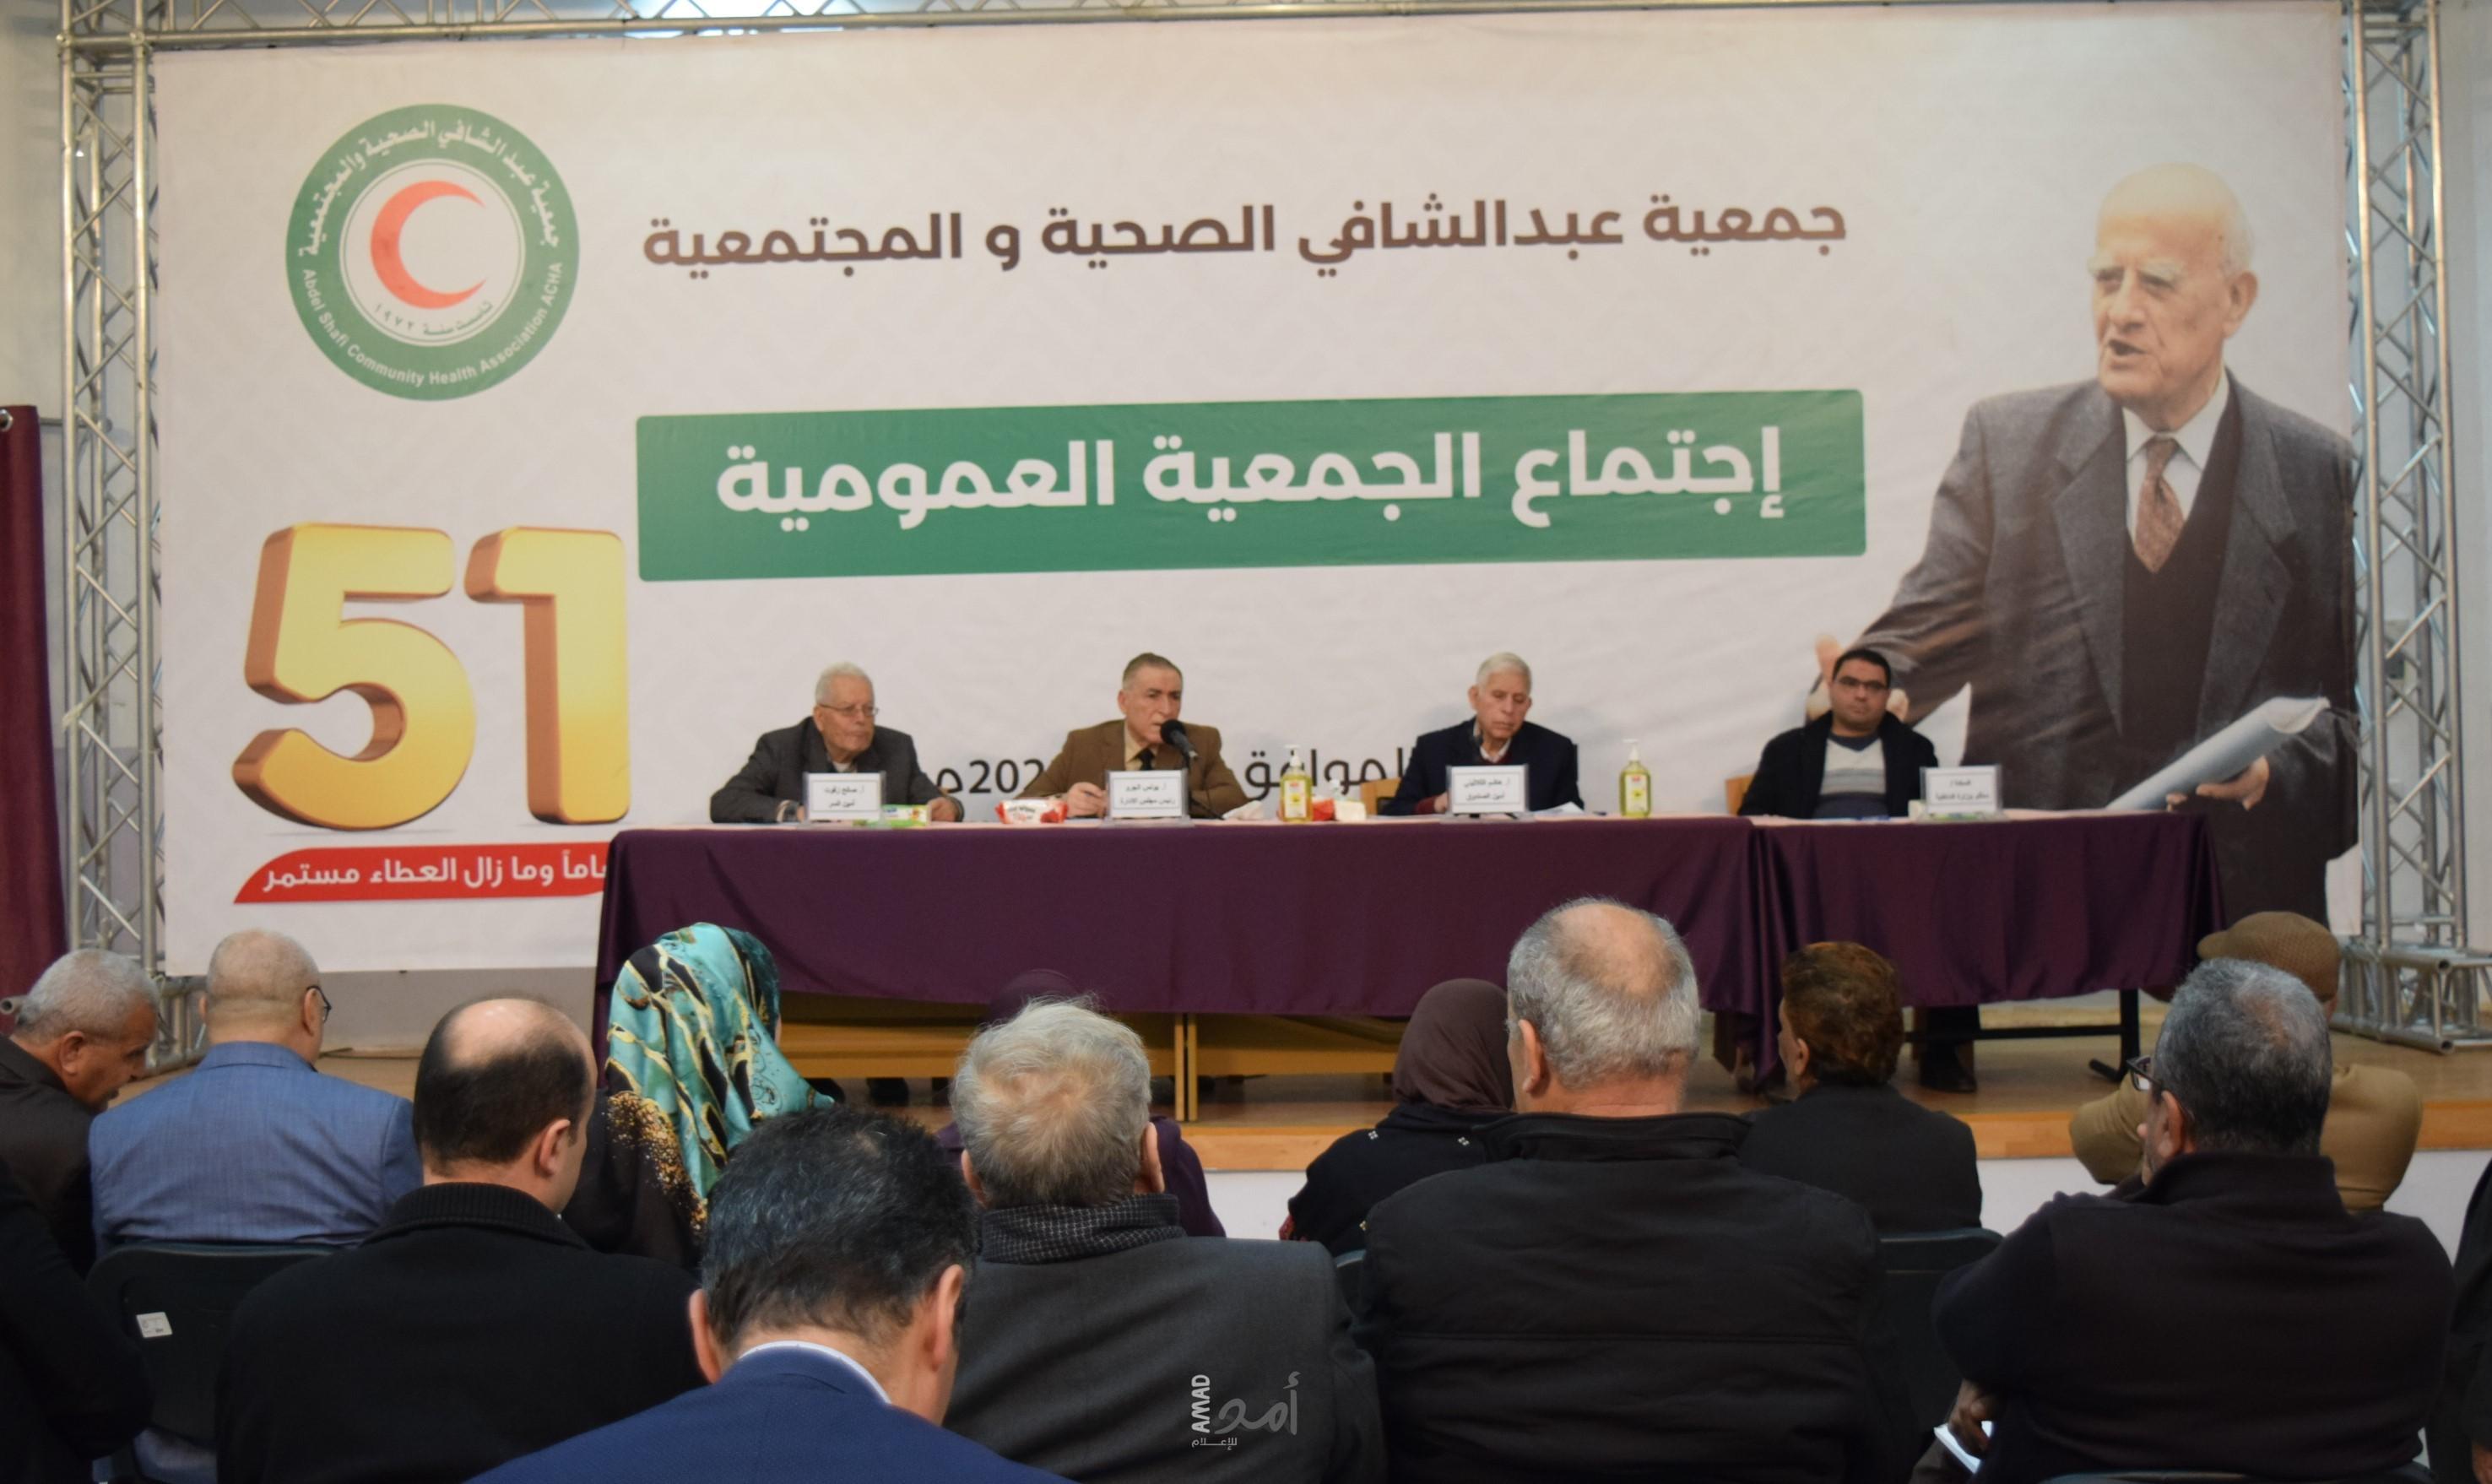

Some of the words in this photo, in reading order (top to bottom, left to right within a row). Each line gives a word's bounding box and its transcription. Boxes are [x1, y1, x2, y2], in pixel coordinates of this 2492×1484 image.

[358, 119, 436, 157] الصحية
[436, 118, 507, 156] الشافي
[501, 151, 537, 187] عبد
[529, 180, 559, 247] جمعية
[1041, 204, 1276, 270] الصحية
[1643, 194, 1846, 257] جمعية
[643, 212, 963, 279] المجتمعية
[984, 224, 1021, 272] و
[302, 268, 326, 312] Abdel
[318, 311, 350, 348] Shafi
[347, 344, 425, 388] Community
[429, 365, 478, 386] Health
[479, 307, 549, 374] Association
[541, 262, 564, 307] ACHA
[716, 440, 1115, 533] العمومية
[1142, 432, 1481, 523] الجمعية
[1511, 426, 1784, 528] إجتماع
[231, 522, 631, 832] 51
[263, 863, 360, 892] مستمر
[370, 857, 457, 883] العطاء
[463, 856, 503, 889] زال
[511, 856, 554, 886] وما
[562, 848, 607, 880] اماً
